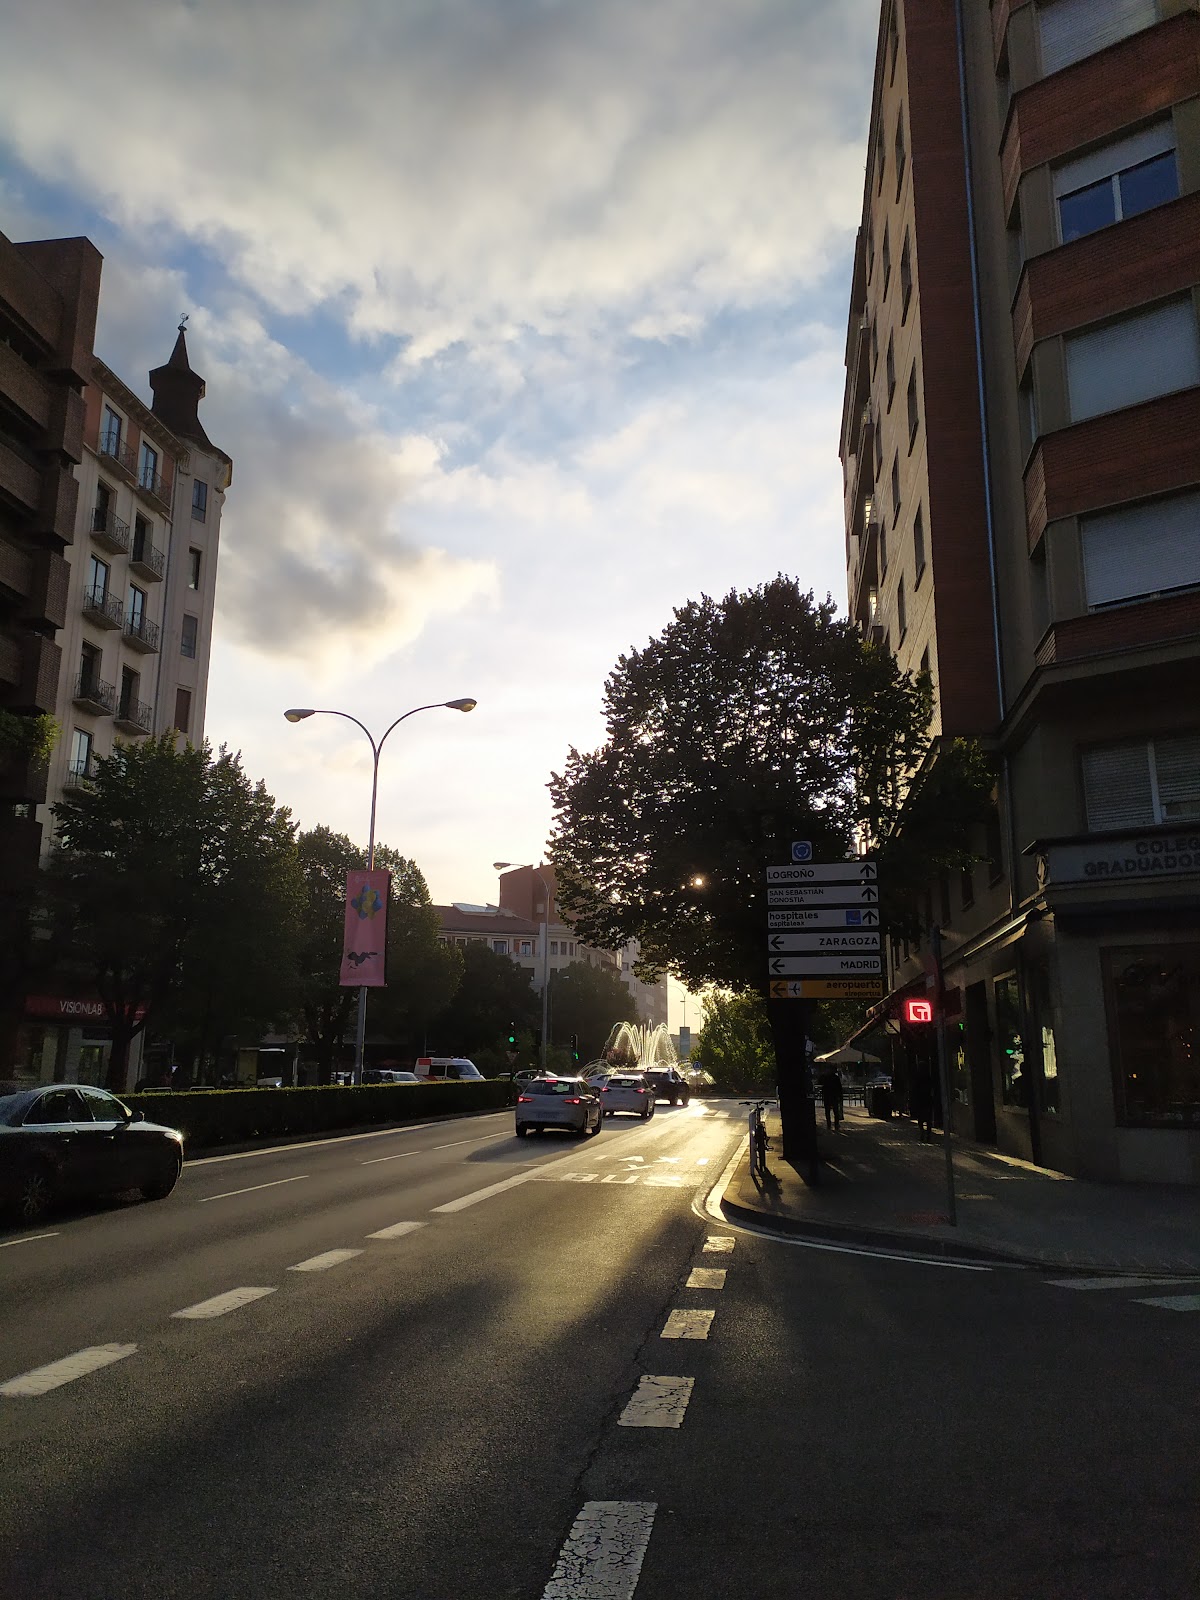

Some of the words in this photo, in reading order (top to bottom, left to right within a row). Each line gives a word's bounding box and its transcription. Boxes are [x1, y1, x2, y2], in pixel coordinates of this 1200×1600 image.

[768, 868, 815, 880] LOGROÑO
[769, 911, 819, 921] hospitales
[769, 920, 805, 928] ospitaleak
[819, 937, 878, 946] ZARAGOZA
[840, 960, 880, 969] MADRID
[826, 981, 881, 990] aeropuerto
[59, 1000, 102, 1015] VISIONLAB
